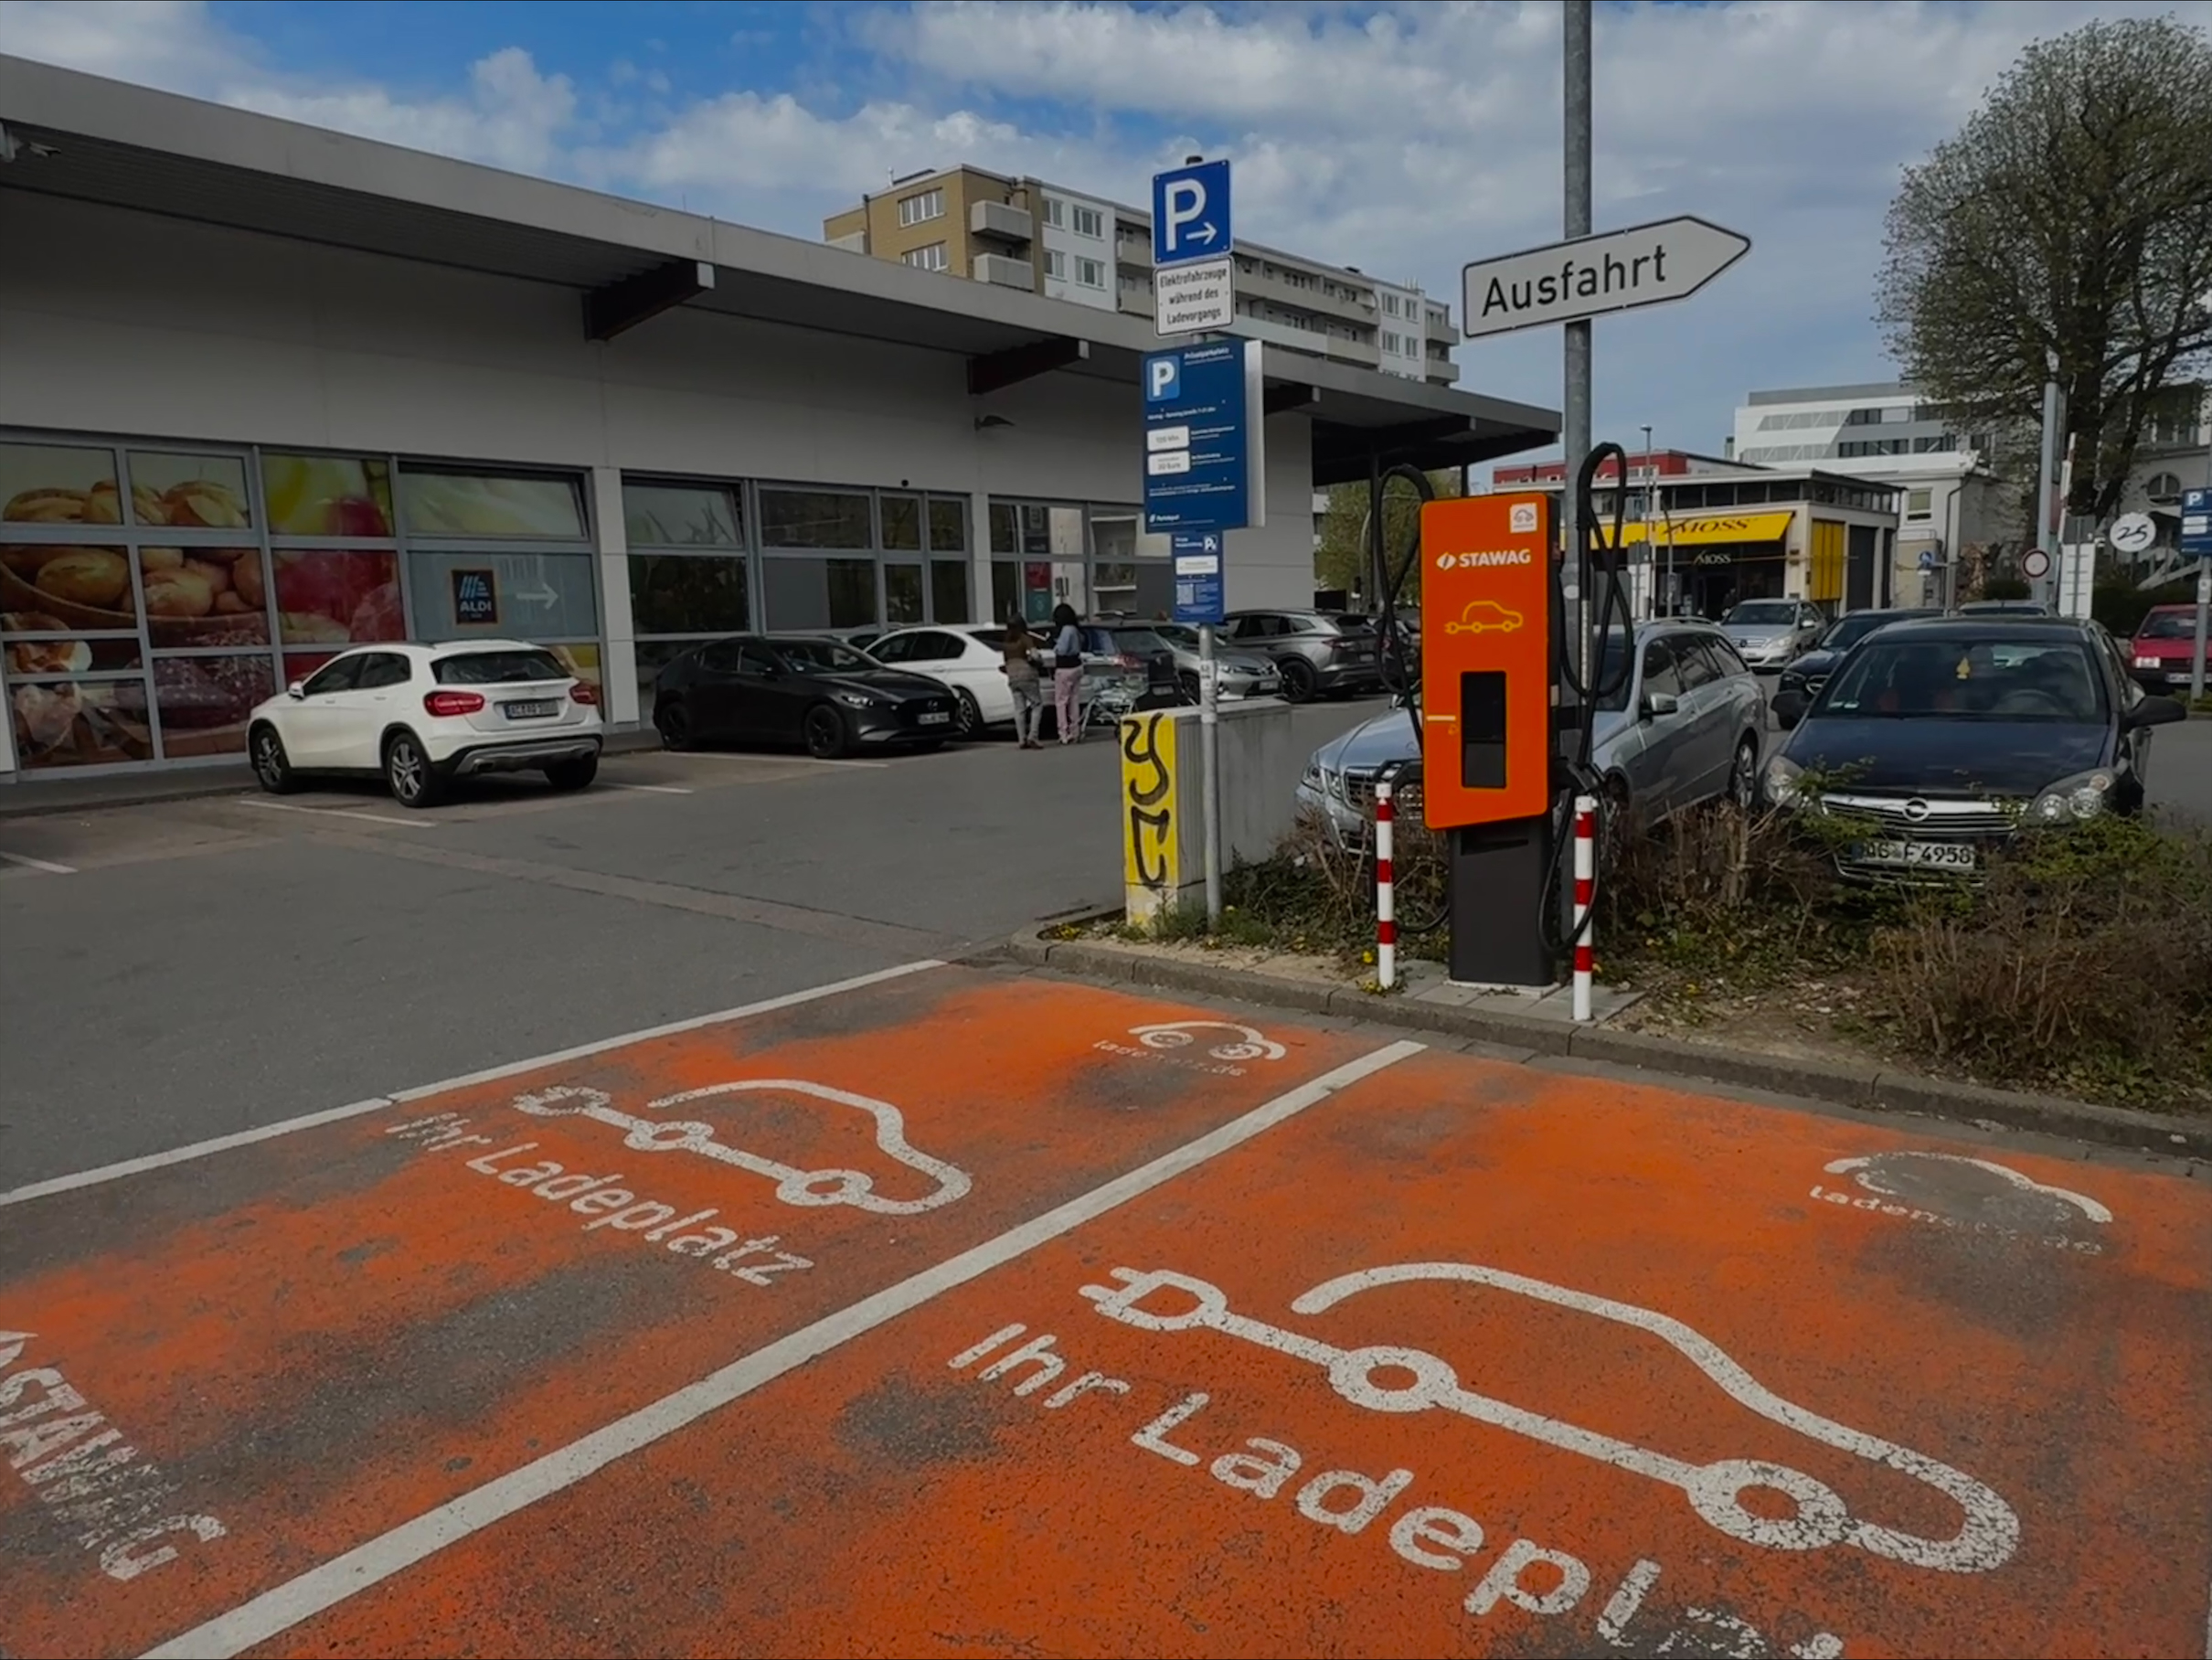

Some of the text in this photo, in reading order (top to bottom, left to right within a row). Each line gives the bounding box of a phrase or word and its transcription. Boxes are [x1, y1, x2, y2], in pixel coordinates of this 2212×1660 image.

[1165, 178, 1207, 251] P
[1160, 268, 1227, 288] Elektrofahrzeuge
[1482, 244, 1666, 317] Ausfahrt
[1169, 288, 1218, 304] während des
[1166, 308, 1221, 325] Ladevorgangs
[1153, 361, 1175, 397] P
[1458, 548, 1531, 568] STAWAG
[460, 601, 492, 612] ALDI
[465, 1143, 814, 1286] Ladeplatz
[949, 1323, 1129, 1409] Ihr
